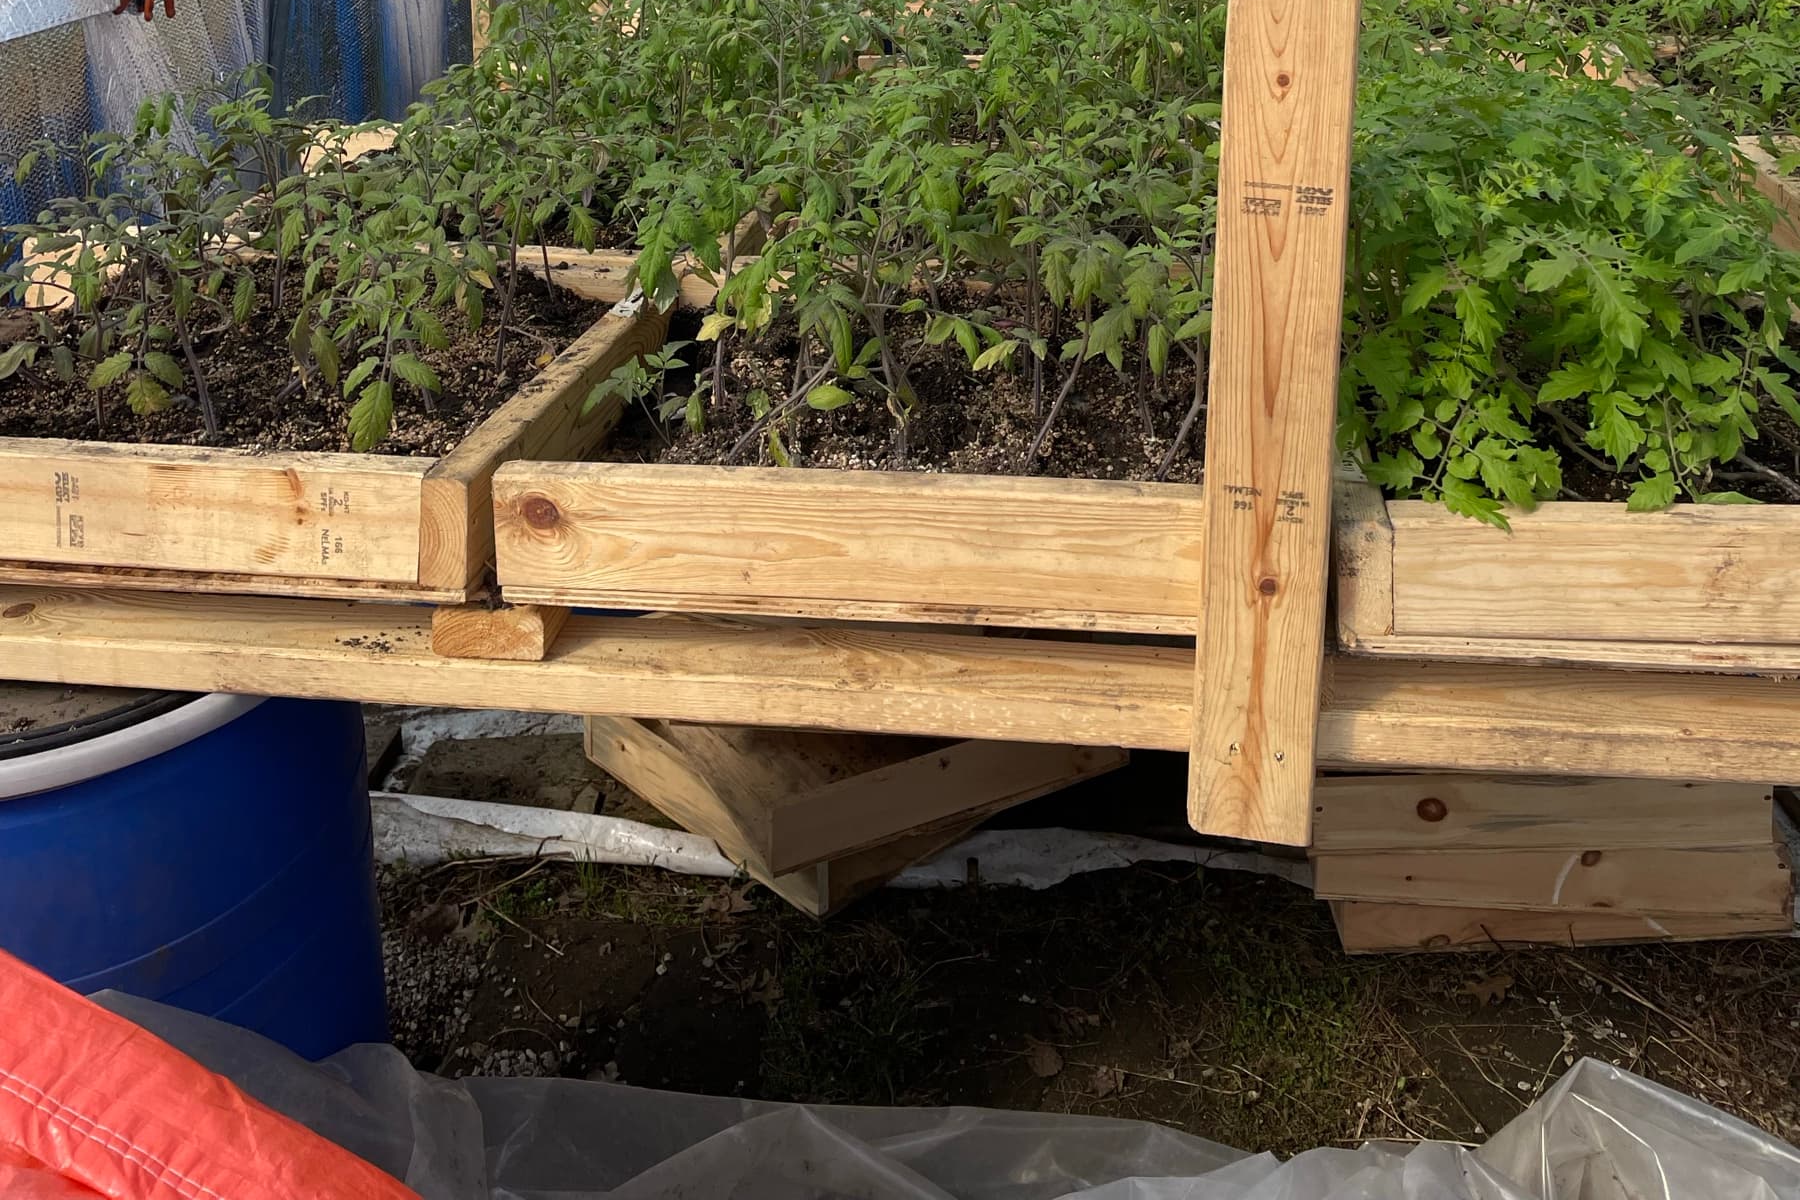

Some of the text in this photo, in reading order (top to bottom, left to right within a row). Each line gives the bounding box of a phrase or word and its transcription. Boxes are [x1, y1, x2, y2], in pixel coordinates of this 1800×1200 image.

[1295, 195, 1334, 206] SELECT
[61, 471, 70, 503] SELECT
[333, 498, 343, 506] 2
[1233, 500, 1254, 511] 166
[1286, 505, 1295, 517] 2
[334, 536, 343, 554] 166
